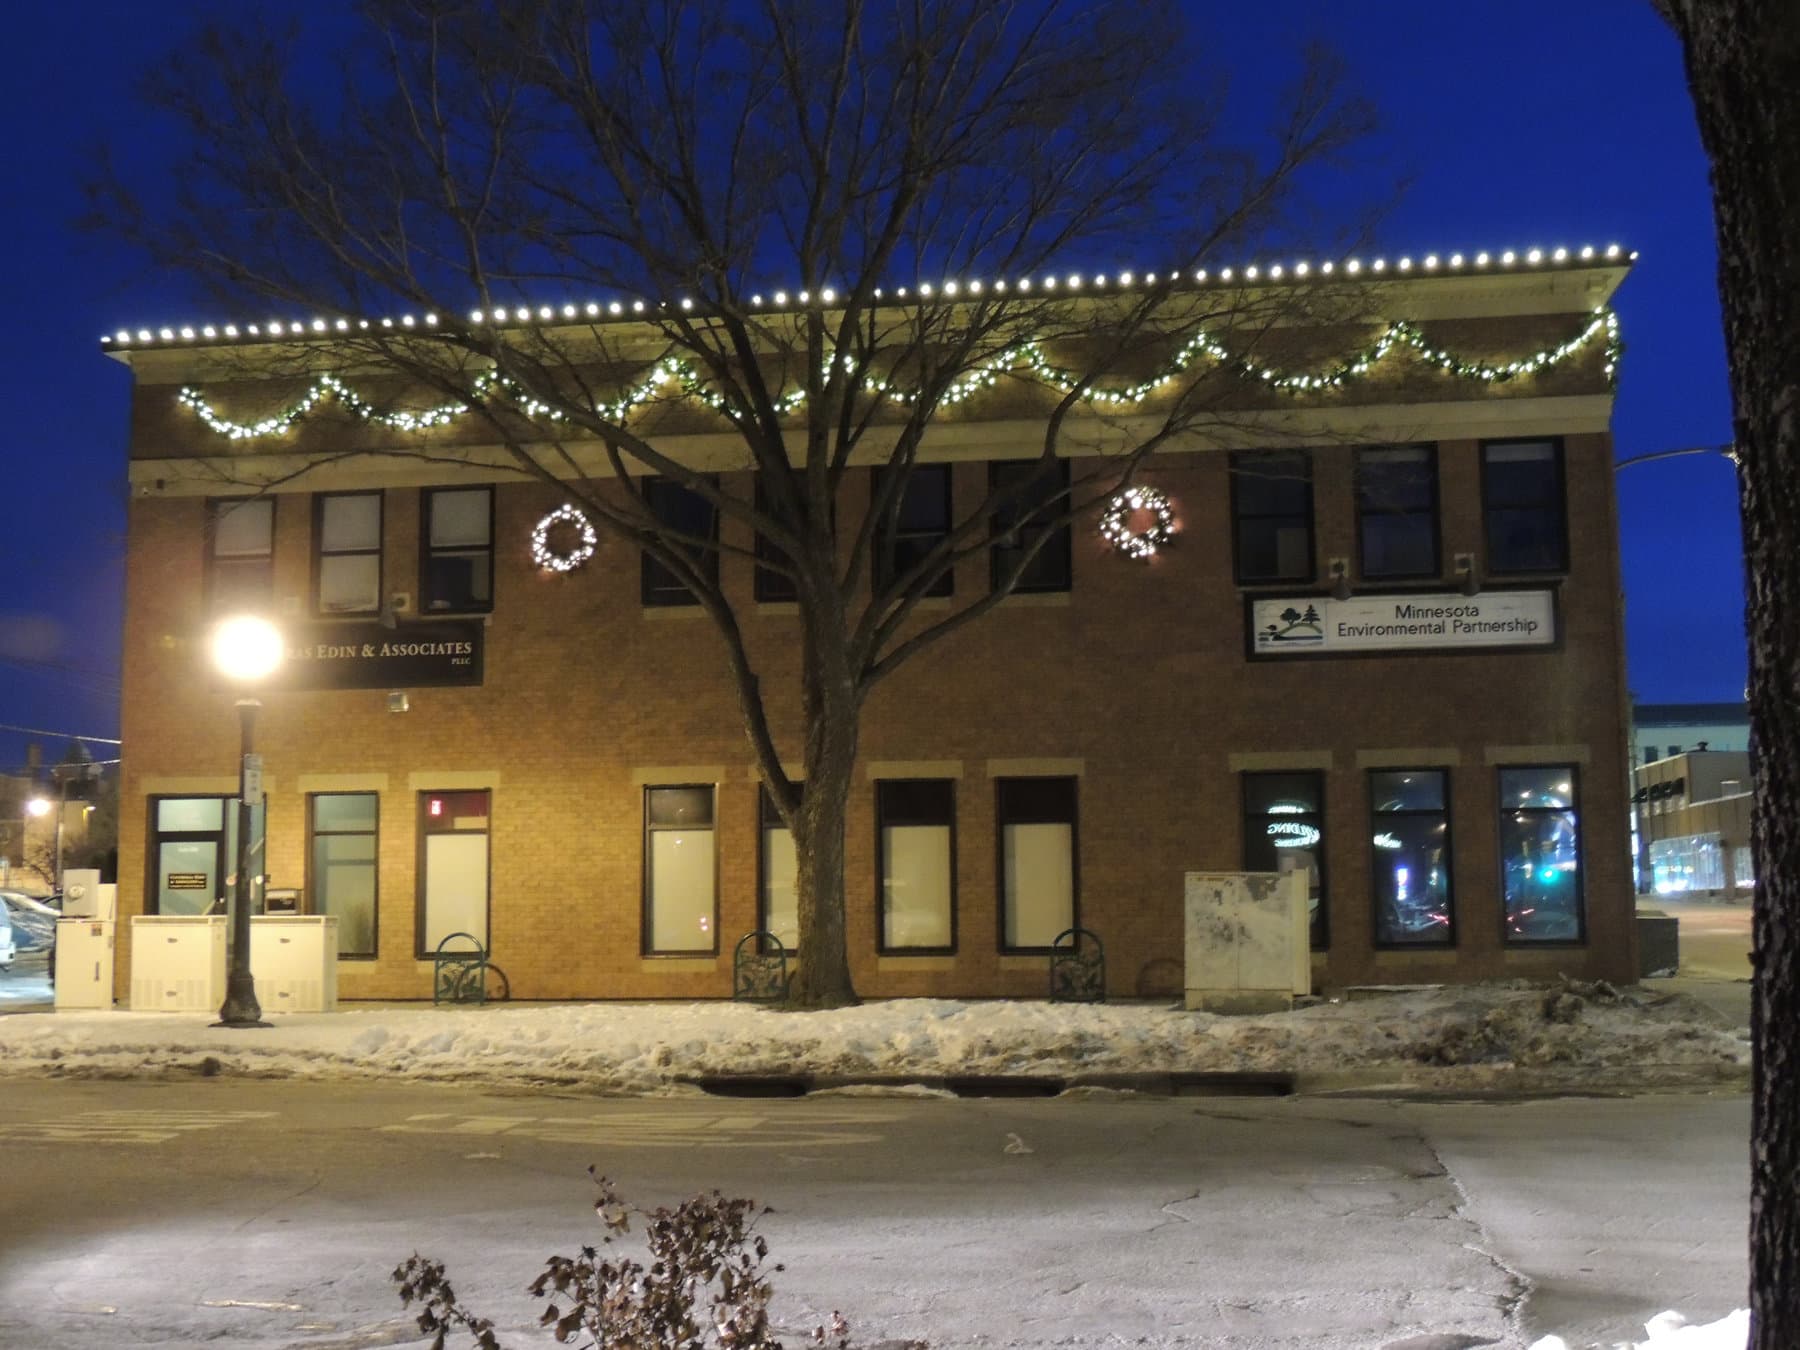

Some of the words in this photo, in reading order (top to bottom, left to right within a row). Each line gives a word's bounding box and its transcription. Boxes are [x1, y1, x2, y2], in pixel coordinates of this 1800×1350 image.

[1395, 604, 1479, 619] Minnesota
[1338, 620, 1445, 637] Environmental
[1453, 618, 1538, 635] Partnership
[361, 644, 376, 657] &
[380, 642, 472, 656] ASSOCIATES
